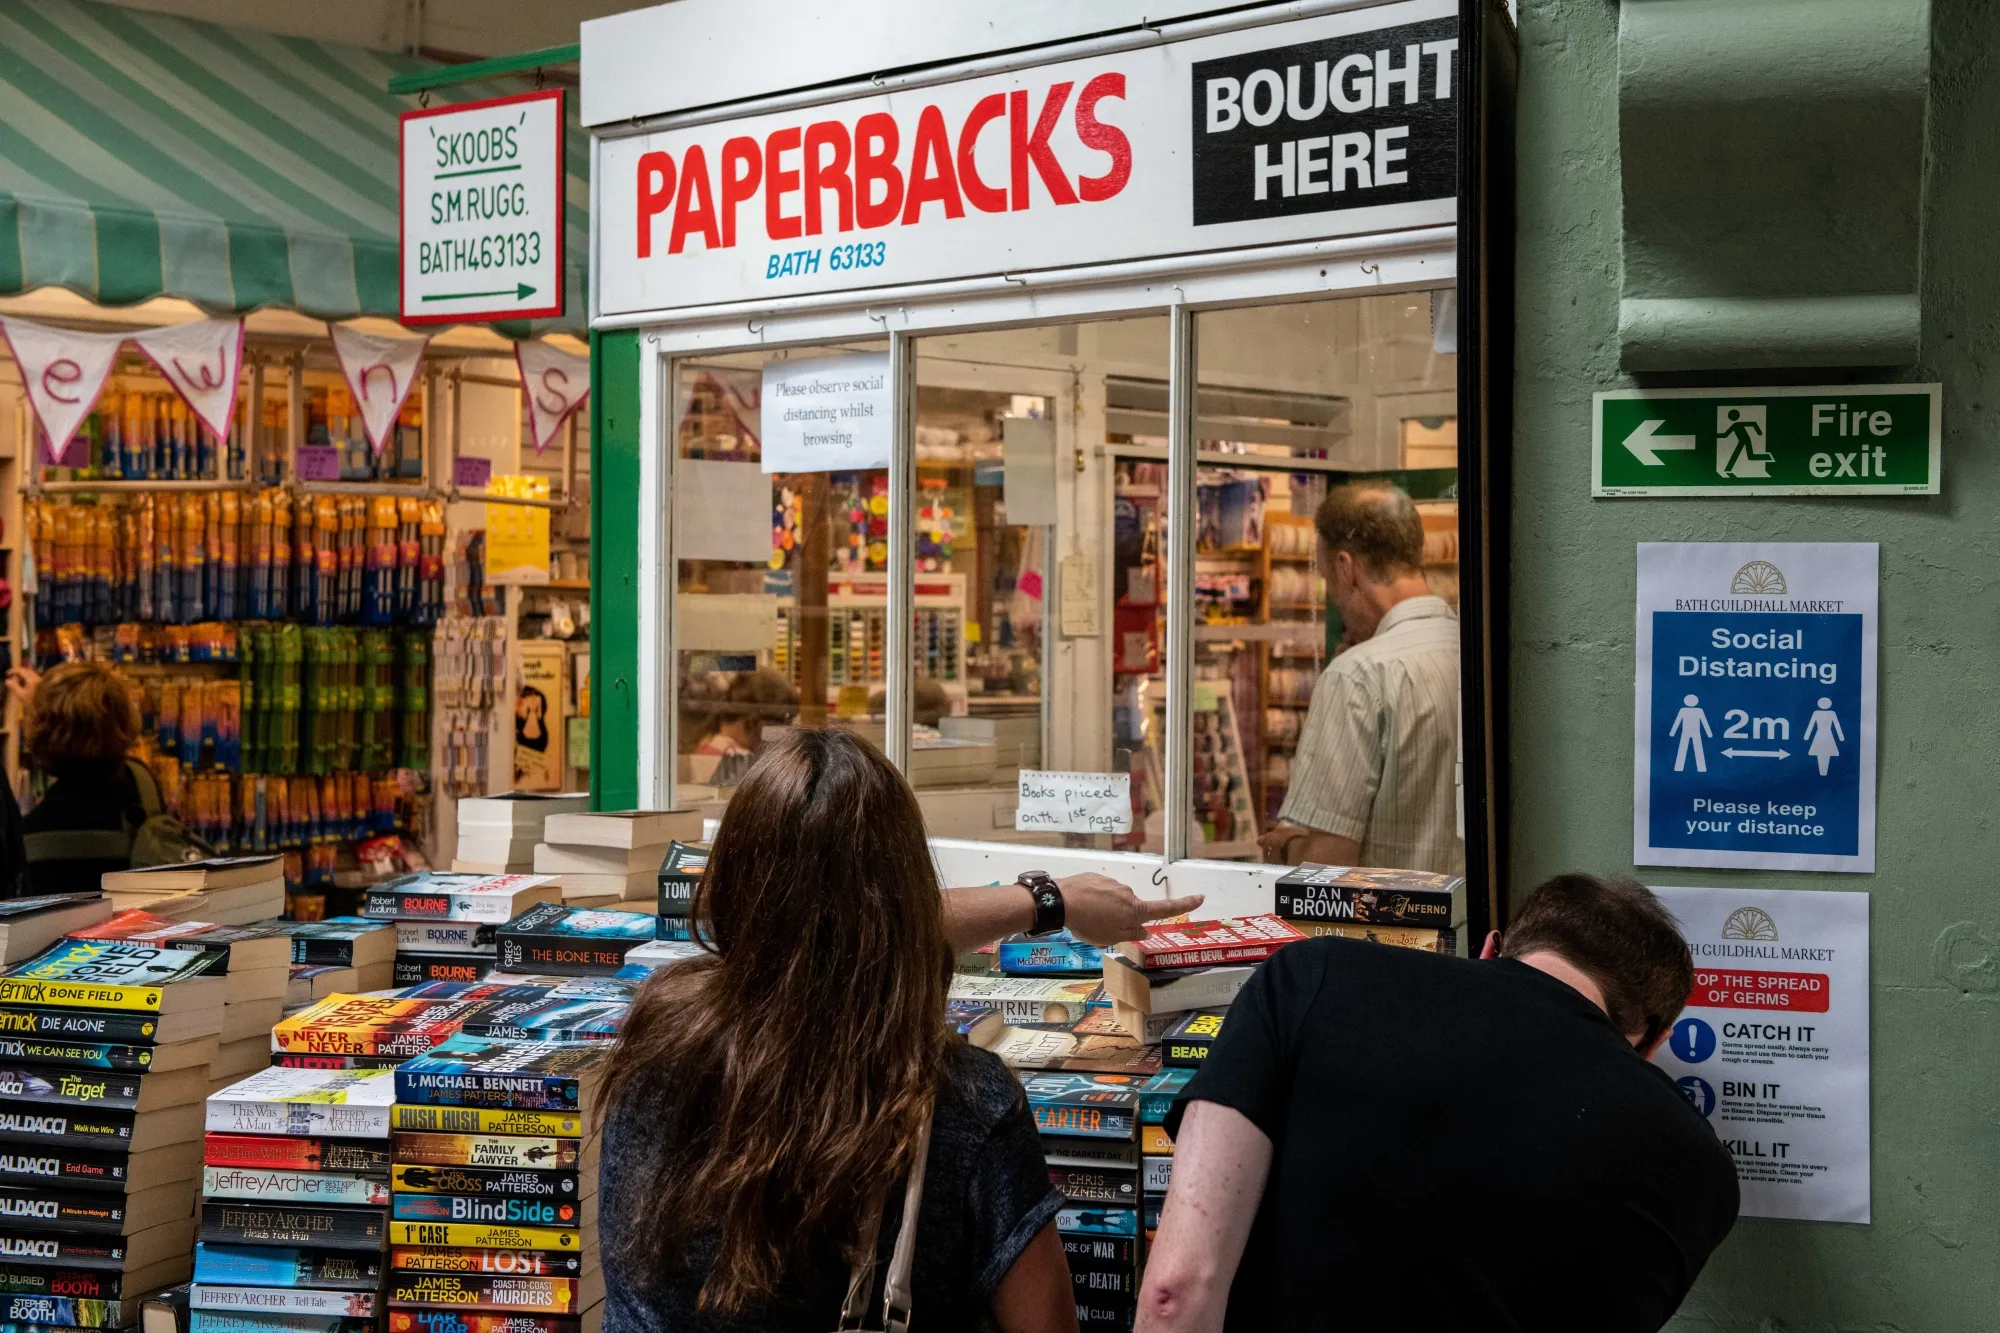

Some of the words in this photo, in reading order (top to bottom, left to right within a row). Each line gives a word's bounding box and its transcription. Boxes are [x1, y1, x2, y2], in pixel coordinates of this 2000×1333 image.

[1205, 38, 1458, 134] BOUGHT
[636, 72, 1133, 259] PAPERBACKS
[1254, 126, 1409, 201] HERE
[766, 248, 821, 279] BATH
[829, 241, 886, 271] 63133
[776, 382, 806, 397] Please
[809, 380, 850, 395] observe
[853, 375, 883, 391] social
[783, 406, 837, 423] distancing
[840, 403, 874, 417] whilst
[1812, 403, 1892, 437] Fire
[803, 430, 853, 448] browsing
[1808, 444, 1887, 478] exit
[1676, 599, 1708, 611] BATH
[1711, 600, 1787, 612] GUILDHALL
[1790, 600, 1843, 613] MARKET
[1711, 628, 1802, 649] Social
[1679, 656, 1837, 684] Distancing
[1723, 709, 1790, 740] 2m
[1021, 783, 1055, 798] Books
[1064, 785, 1118, 804] priced
[1693, 799, 1760, 815] Please
[1767, 801, 1816, 820] keep
[1068, 807, 1086, 822] 1st
[1088, 816, 1127, 832] page
[1686, 820, 1731, 834] your
[1738, 820, 1824, 836] distance
[664, 882, 690, 899] TOM
[1306, 886, 1341, 900] DAN
[371, 896, 395, 905] Robert
[404, 898, 448, 910] BOURNE
[1293, 898, 1354, 918] BROWN
[428, 930, 468, 940] BOURNE
[532, 949, 552, 961] THE
[556, 950, 590, 962] BONE
[594, 952, 619, 964] TREE
[1018, 955, 1066, 966] McDERMOTT
[1031, 948, 1052, 957] ANDY
[1155, 954, 1182, 966] TOUCH
[1184, 952, 1199, 963] THE
[1200, 950, 1225, 961] DEVIL
[1227, 949, 1242, 958] JACK
[1243, 947, 1268, 957] HIGGINS
[1702, 944, 1778, 958] GUILDHALL
[1781, 948, 1834, 961] MARKET
[1694, 974, 1718, 986] OP
[1723, 975, 1753, 987] THE
[1758, 978, 1820, 991] SPREAD
[49, 988, 85, 999] BONE
[88, 991, 123, 1002] FIELD
[1709, 990, 1729, 1002] OF
[1733, 992, 1789, 1005] GERMS
[41, 1017, 61, 1029] DIE
[63, 1019, 105, 1032] ALONE
[1723, 1023, 1790, 1041] CATCH
[1798, 1027, 1815, 1042] IT
[294, 1031, 348, 1042] NEVER
[308, 1042, 364, 1054] NEVER
[392, 1035, 430, 1045] JAMES
[27, 1045, 42, 1055] WE
[44, 1047, 64, 1057] CAN
[66, 1048, 81, 1058] SEE
[83, 1050, 103, 1059] YOU
[1172, 1047, 1209, 1058] BEAR
[60, 1077, 106, 1101] Target
[419, 1076, 479, 1089] MICHAEL
[484, 1077, 543, 1092] BENNETT
[1723, 1082, 1756, 1097] BIN
[1763, 1084, 1780, 1099] IT
[230, 1104, 254, 1116] This
[255, 1105, 277, 1116] Was
[331, 1108, 367, 1120] JEFFREY
[400, 1108, 437, 1129] HUSH
[442, 1110, 480, 1130] HUSH
[502, 1113, 541, 1123] JAMES
[1035, 1107, 1101, 1131] CARTER
[74, 1124, 88, 1132] Walk
[100, 1126, 115, 1134] Wire
[233, 1117, 244, 1129] A
[246, 1118, 271, 1130] Man
[325, 1118, 371, 1132] ARCHER
[489, 1123, 555, 1134] PATTERSON
[474, 1144, 515, 1155] FAMILY
[1072, 1150, 1105, 1159] DARKEST
[1108, 1152, 1122, 1160] DAY
[1772, 1143, 1790, 1158] IT
[471, 1155, 518, 1165] LAWYER
[66, 1164, 81, 1172] End
[82, 1165, 104, 1175] Game
[500, 1173, 539, 1183] JAMES
[213, 1171, 266, 1194] Jeffrey
[266, 1174, 324, 1193] Archer
[1068, 1173, 1104, 1185] CHRIS
[486, 1183, 553, 1194] PATTERSON
[220, 1209, 275, 1230] JEFFREY
[274, 1212, 333, 1231] ARCHER
[419, 1225, 449, 1244] CASE
[1080, 1244, 1092, 1252] OF
[1093, 1242, 1114, 1258] WAR
[481, 1249, 546, 1274] LOST
[10, 1275, 44, 1285] BURIED
[52, 1280, 99, 1296] BOOTH
[415, 1277, 461, 1289] JAMES
[493, 1280, 552, 1290] COAST-TO-COAST
[1076, 1274, 1087, 1283] OF
[1090, 1272, 1120, 1290] DEATH
[14, 1299, 52, 1308] STEPHEN
[201, 1290, 241, 1304] JEFFREY
[241, 1292, 286, 1306] ARCHER
[294, 1297, 308, 1305] Tell
[310, 1298, 327, 1307] Tale
[396, 1290, 478, 1303] PATTERSON
[493, 1290, 553, 1305] MURDERS
[10, 1306, 55, 1321] BOOTH
